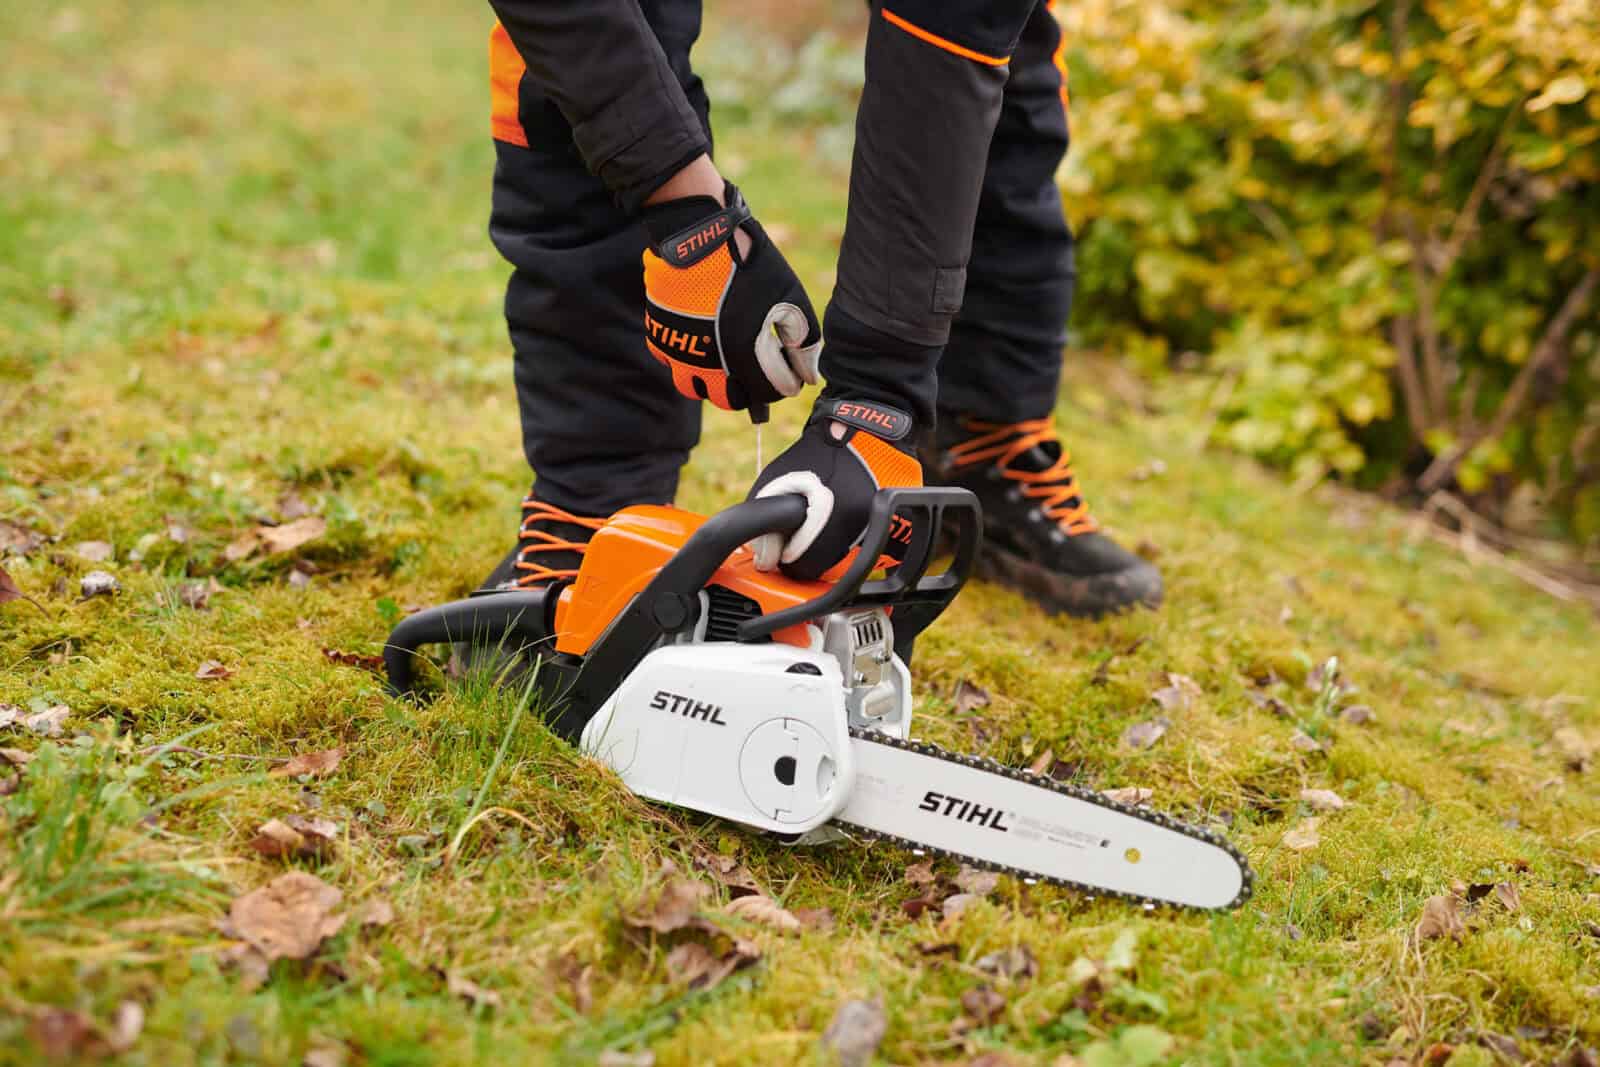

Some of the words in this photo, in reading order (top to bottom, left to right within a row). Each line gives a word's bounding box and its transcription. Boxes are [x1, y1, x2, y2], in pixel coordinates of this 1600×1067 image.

[676, 219, 728, 259] STIHL
[837, 403, 893, 429] STIHL
[650, 691, 727, 726] STIHL
[919, 791, 1008, 832] STIHL
